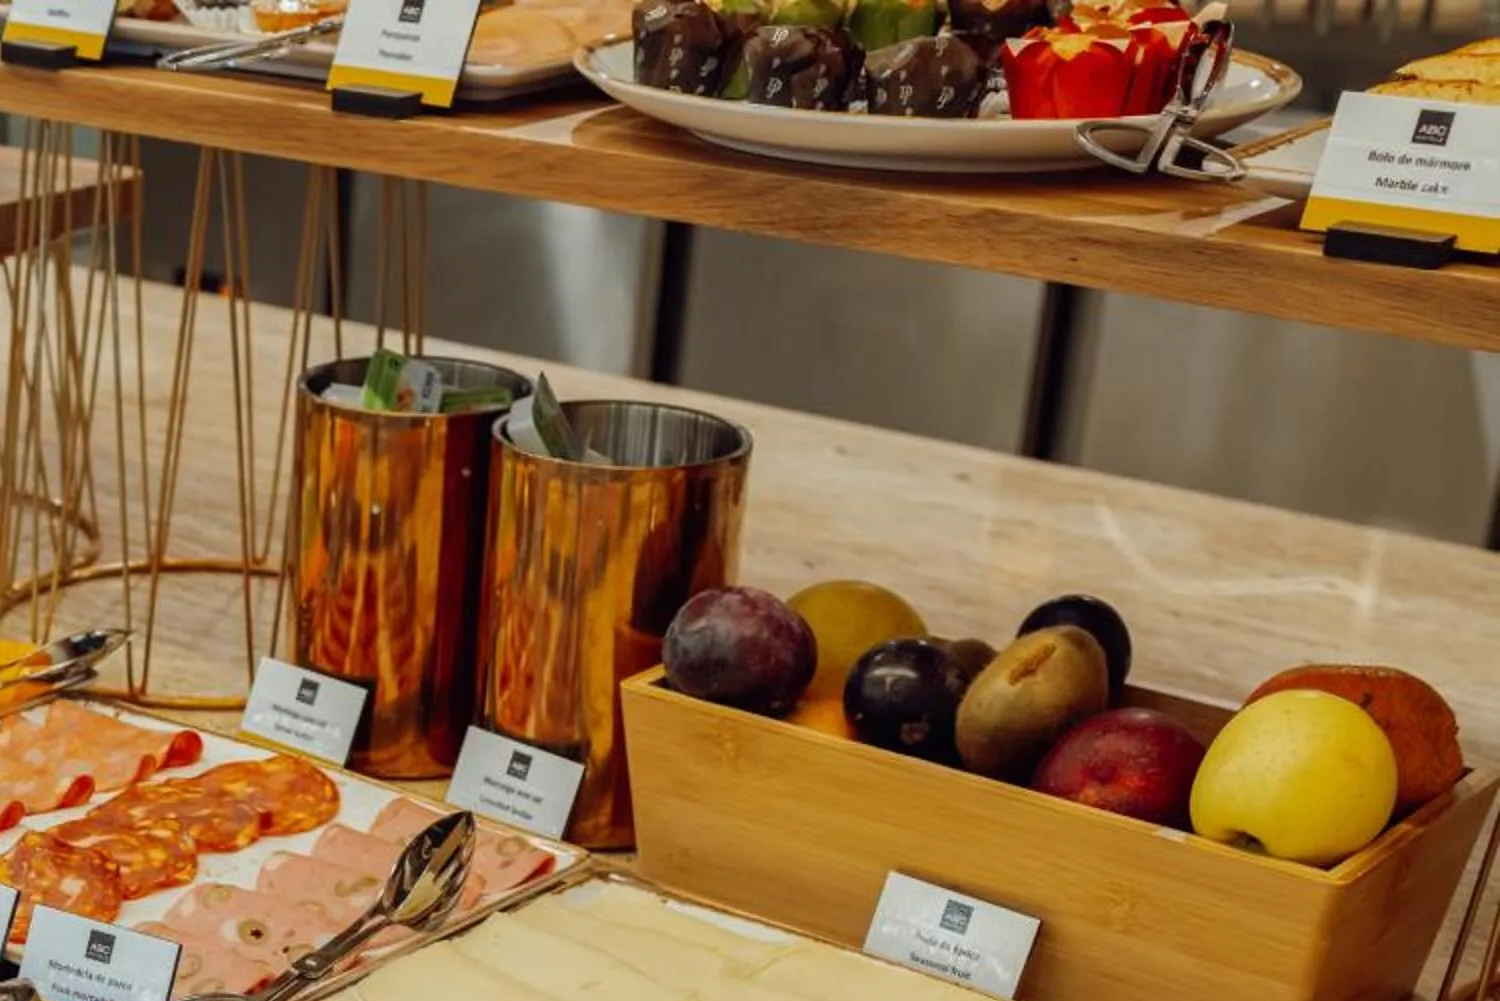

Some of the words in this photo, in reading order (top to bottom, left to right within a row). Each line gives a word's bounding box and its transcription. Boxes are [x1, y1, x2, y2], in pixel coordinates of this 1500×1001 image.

[1418, 124, 1447, 136] ABC
[1367, 150, 1395, 163] Bolo
[1398, 154, 1412, 165] de
[1374, 176, 1418, 190] Marble
